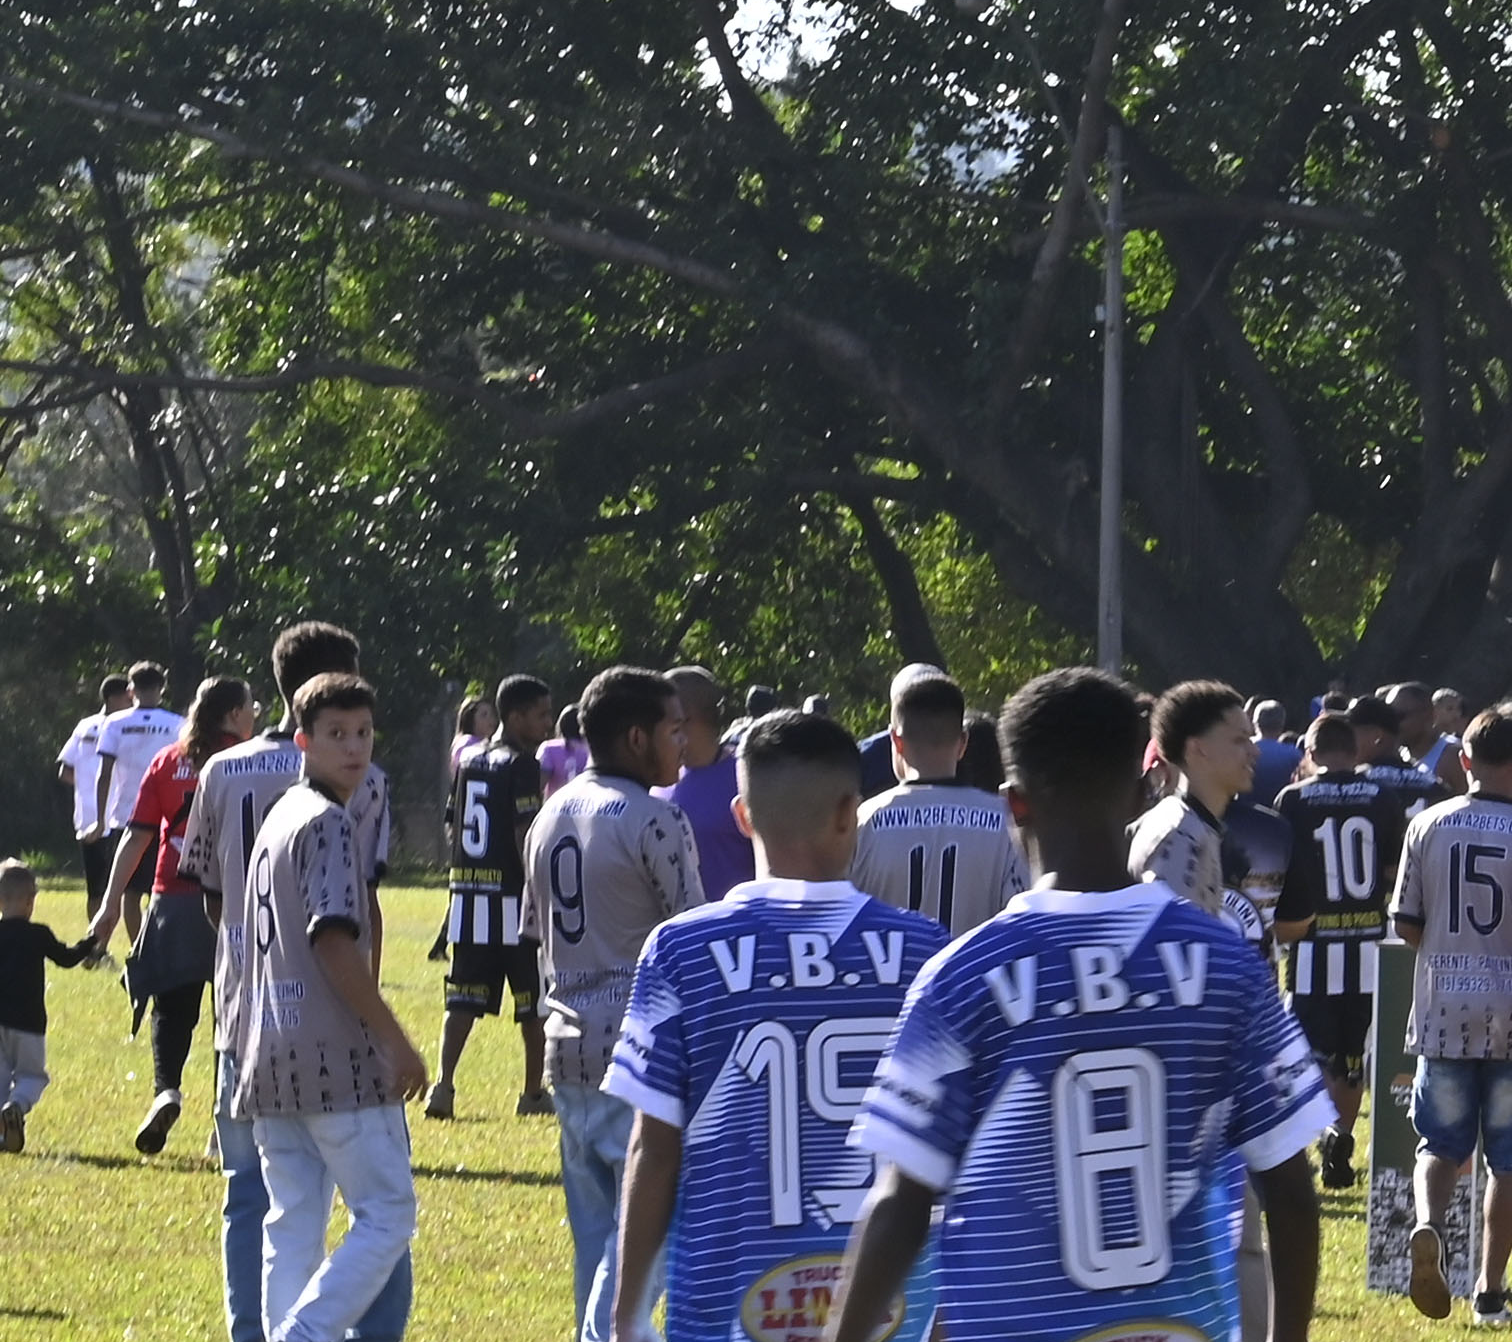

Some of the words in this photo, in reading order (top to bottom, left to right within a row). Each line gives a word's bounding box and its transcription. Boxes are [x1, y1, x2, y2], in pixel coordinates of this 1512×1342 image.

[462, 779, 489, 859] 5
[1313, 815, 1377, 902] 10
[255, 846, 277, 956] 8
[550, 834, 586, 945] 9
[908, 843, 959, 935] 11
[1448, 841, 1507, 936] 15
[709, 931, 905, 995] V.B.V
[982, 941, 1210, 1027] V.B.V
[1053, 1048, 1172, 1291] 8
